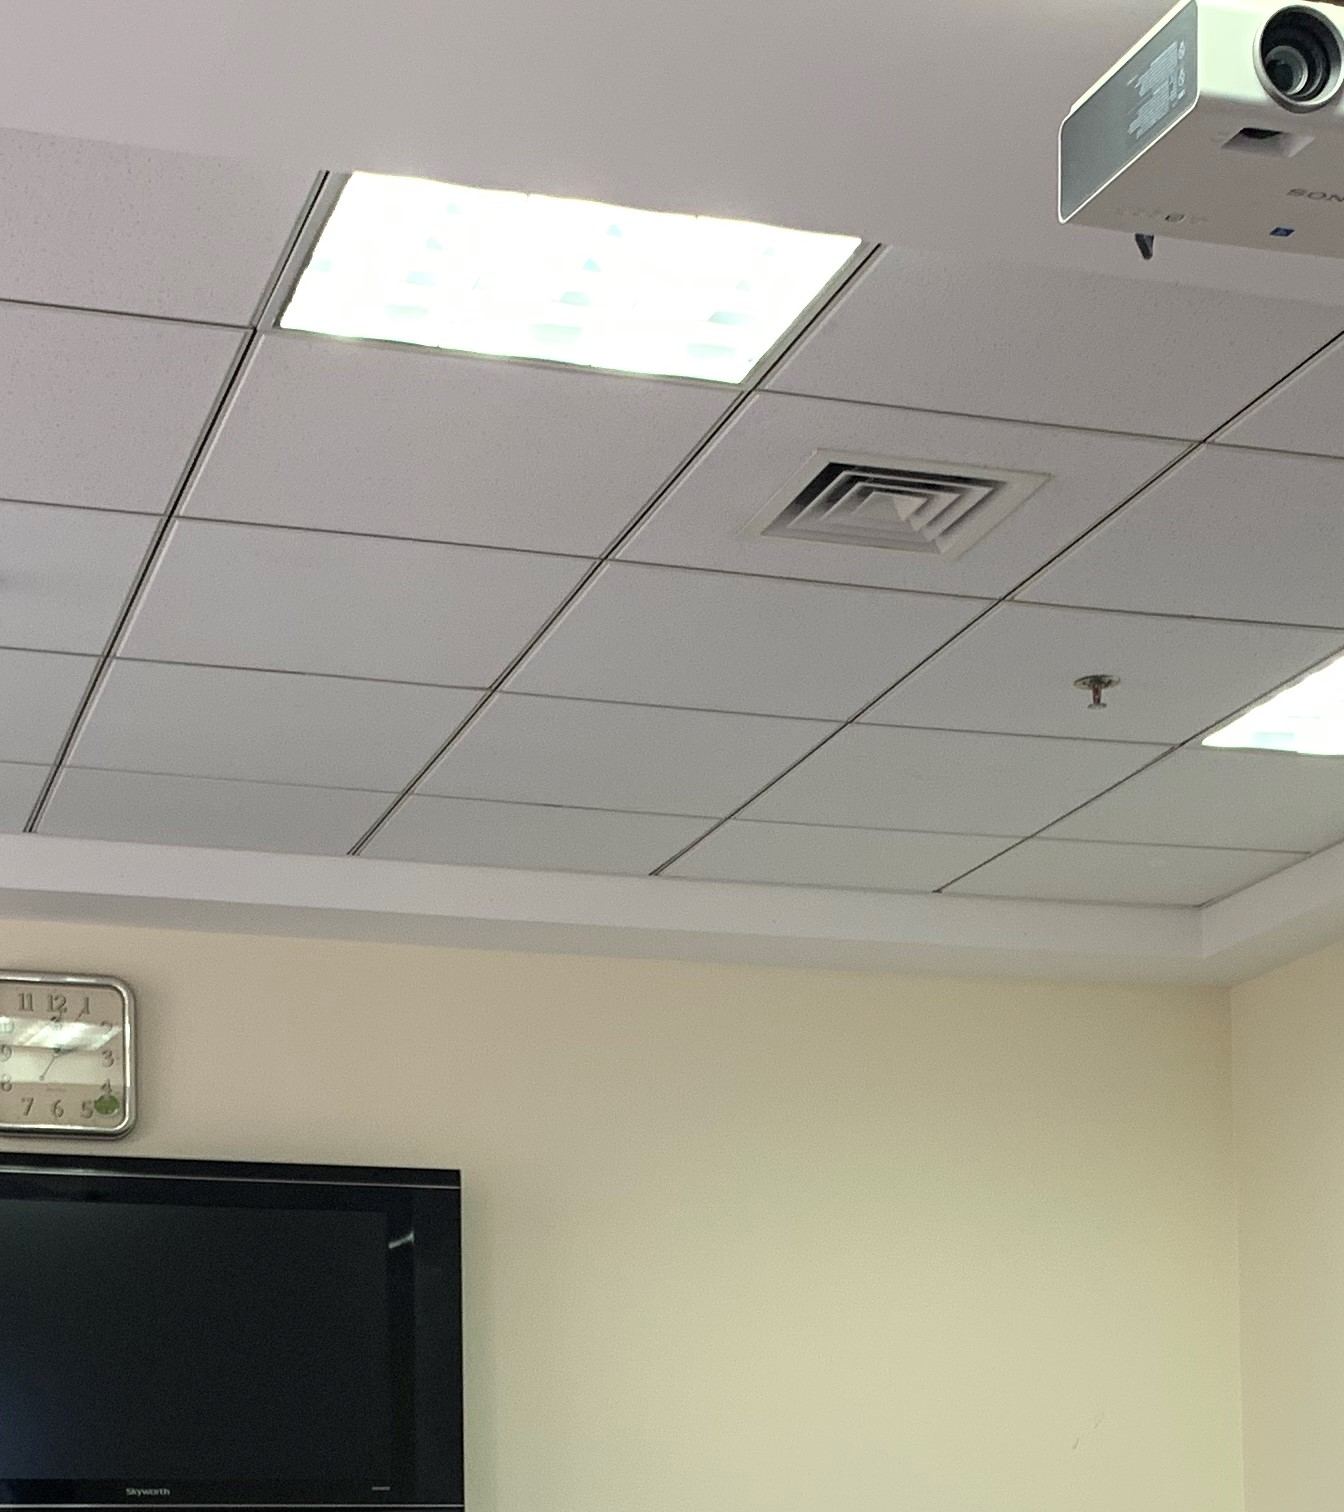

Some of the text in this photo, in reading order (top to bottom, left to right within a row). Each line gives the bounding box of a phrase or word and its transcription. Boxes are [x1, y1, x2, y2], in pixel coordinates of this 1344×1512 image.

[17, 992, 34, 1012] 11
[46, 993, 67, 1014] 12
[101, 1049, 115, 1068] 3
[0, 1073, 13, 1093] 8
[21, 1097, 94, 1119] 7 6 5
[125, 1487, 171, 1497] Skyworth
